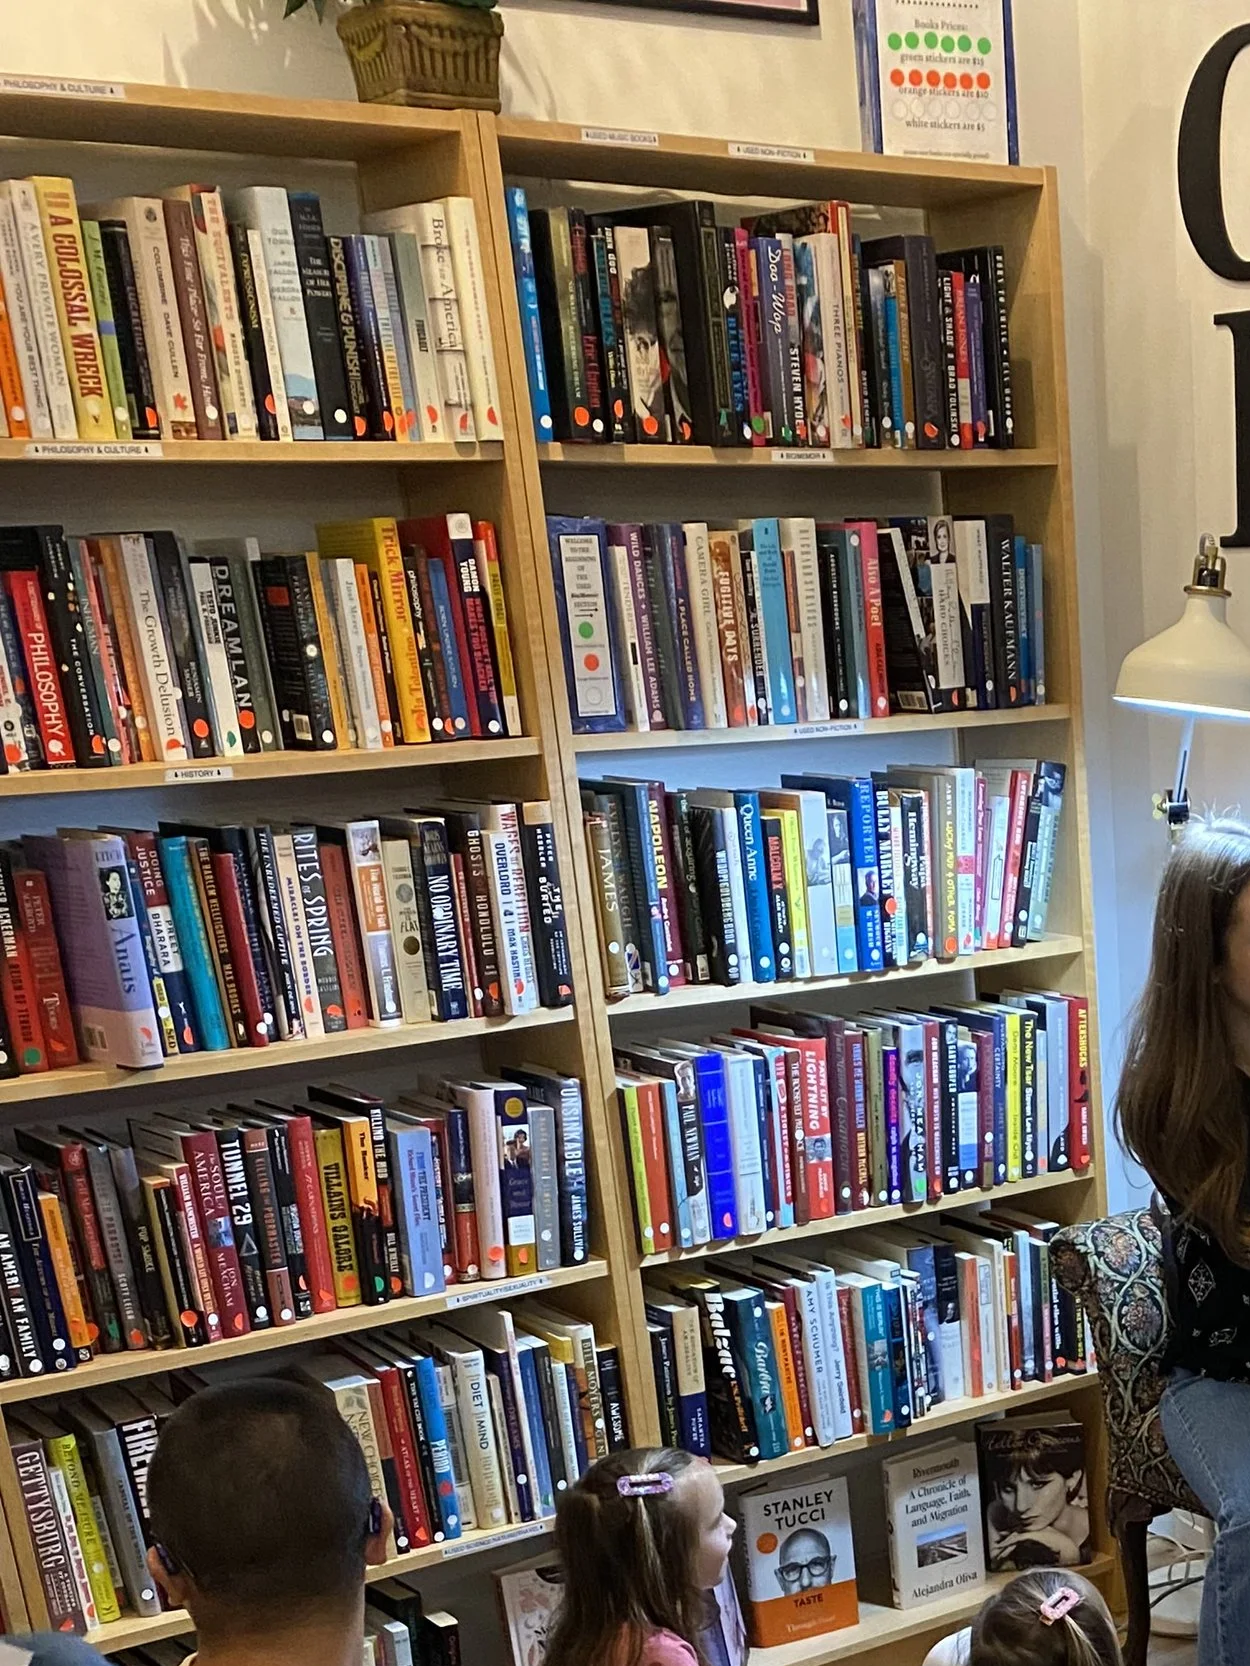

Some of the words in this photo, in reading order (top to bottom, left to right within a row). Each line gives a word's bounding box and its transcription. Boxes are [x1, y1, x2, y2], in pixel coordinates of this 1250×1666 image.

[914, 19, 939, 29] Books
[900, 54, 923, 64] green
[926, 53, 956, 63] stickers
[972, 58, 984, 66] $15
[3, 79, 58, 92] PHILOSOPHY
[68, 84, 108, 95] CULTURE
[899, 88, 927, 97] orange
[929, 88, 960, 97] stickers
[906, 119, 928, 128] white
[930, 120, 960, 130] stickers
[977, 124, 985, 132] $5
[50, 213, 72, 226] A
[53, 232, 91, 326] COLOSSAL
[152, 246, 169, 306] COLUMBINE
[432, 217, 445, 263] Broke
[441, 282, 463, 347] America
[942, 278, 952, 302] LIGHT
[163, 312, 174, 339] DAVE
[329, 238, 351, 312] DISCIPLINE
[342, 328, 359, 383] PUNISH
[831, 304, 840, 339] THREE
[945, 317, 954, 347] SHADE
[49, 332, 66, 386] WOMAN
[72, 332, 103, 398] WRECK
[168, 342, 180, 379] CULLEN
[789, 348, 801, 387] STEVEN
[834, 345, 845, 384] PIANOS
[947, 365, 956, 389] BRAD
[949, 391, 960, 434] TOLINSKI
[42, 445, 97, 454] PHILOSOPHY
[104, 446, 142, 454] CULTURE
[381, 525, 399, 568] Trick
[630, 532, 640, 558] WILD
[695, 535, 708, 586] CAMERA
[459, 560, 472, 592] YOUNG
[467, 558, 480, 592] DAMON
[634, 560, 646, 600] DANCES
[867, 558, 878, 584] Also
[1001, 538, 1014, 596] WALTER
[389, 571, 408, 623] Mirror
[407, 570, 423, 619] philosophy
[700, 588, 711, 615] GIRL
[717, 570, 735, 626] FUGITIVE
[641, 615, 655, 657] WILLIAM
[724, 627, 738, 662] DAYS
[1003, 600, 1017, 680] KAUFMANN
[139, 590, 150, 612] The
[145, 614, 162, 670] Growth
[156, 672, 176, 737] Delusion
[646, 658, 657, 674] LEE
[27, 632, 65, 737] PHILOSOPHY
[75, 661, 95, 736] CONVERSATION
[649, 676, 660, 711] ADAMS
[181, 770, 214, 779] HISTORY
[739, 803, 754, 843] Queen
[859, 783, 875, 865] REPORTER
[875, 790, 891, 837] BULLY
[293, 833, 322, 882] RITES
[648, 800, 668, 890] NAPOLEON
[745, 849, 757, 881] Anne
[904, 811, 920, 889] Hemingway
[136, 846, 156, 896] JUSTICE
[150, 850, 164, 888] DOING
[428, 875, 451, 893] NO
[495, 842, 511, 896] OVERLORD
[597, 848, 620, 914] JAMES
[879, 839, 893, 896] MARKET
[0, 907, 18, 958] ACKERMAN
[151, 913, 170, 967] BHARARA
[165, 919, 180, 956] PREET
[304, 895, 333, 957] SPRING
[438, 955, 462, 992] TIME
[1078, 1008, 1088, 1068] AFTERSHOCKS
[805, 1050, 820, 1130] LIGHTNING
[370, 1108, 384, 1145] KILLING
[681, 1104, 693, 1128] PAUL
[686, 1129, 700, 1162] NEWMAN
[193, 1150, 216, 1217] AMERICA
[220, 1139, 243, 1201] TUNNEL
[232, 1203, 253, 1226] 29
[323, 1162, 344, 1223] VILLAINS
[332, 1225, 353, 1273] GALORE
[216, 1252, 235, 1307] MEACHAM
[806, 1290, 816, 1311] AMY
[18, 1311, 37, 1358] FAMILY
[704, 1292, 735, 1379] Balzac
[810, 1314, 823, 1373] SCHUMER
[473, 1382, 483, 1408] DIET
[477, 1418, 489, 1450] MIND
[610, 1402, 623, 1442] AWESOME
[62, 1443, 80, 1488] BEYOND
[912, 1459, 959, 1478] Rivermouth
[762, 1489, 834, 1518] STANLEY
[905, 1496, 947, 1513] Language,
[950, 1490, 971, 1504] Faith,
[909, 1489, 918, 1500] A
[922, 1479, 955, 1499] Chronicle
[16, 1451, 65, 1569] GETTYSBURG
[774, 1508, 826, 1531] TUCCI
[911, 1516, 926, 1527] and
[928, 1504, 968, 1523] Migration
[793, 1593, 824, 1608] TASTE
[911, 1576, 953, 1599] Alejandra
[956, 1571, 978, 1585] Oliva
